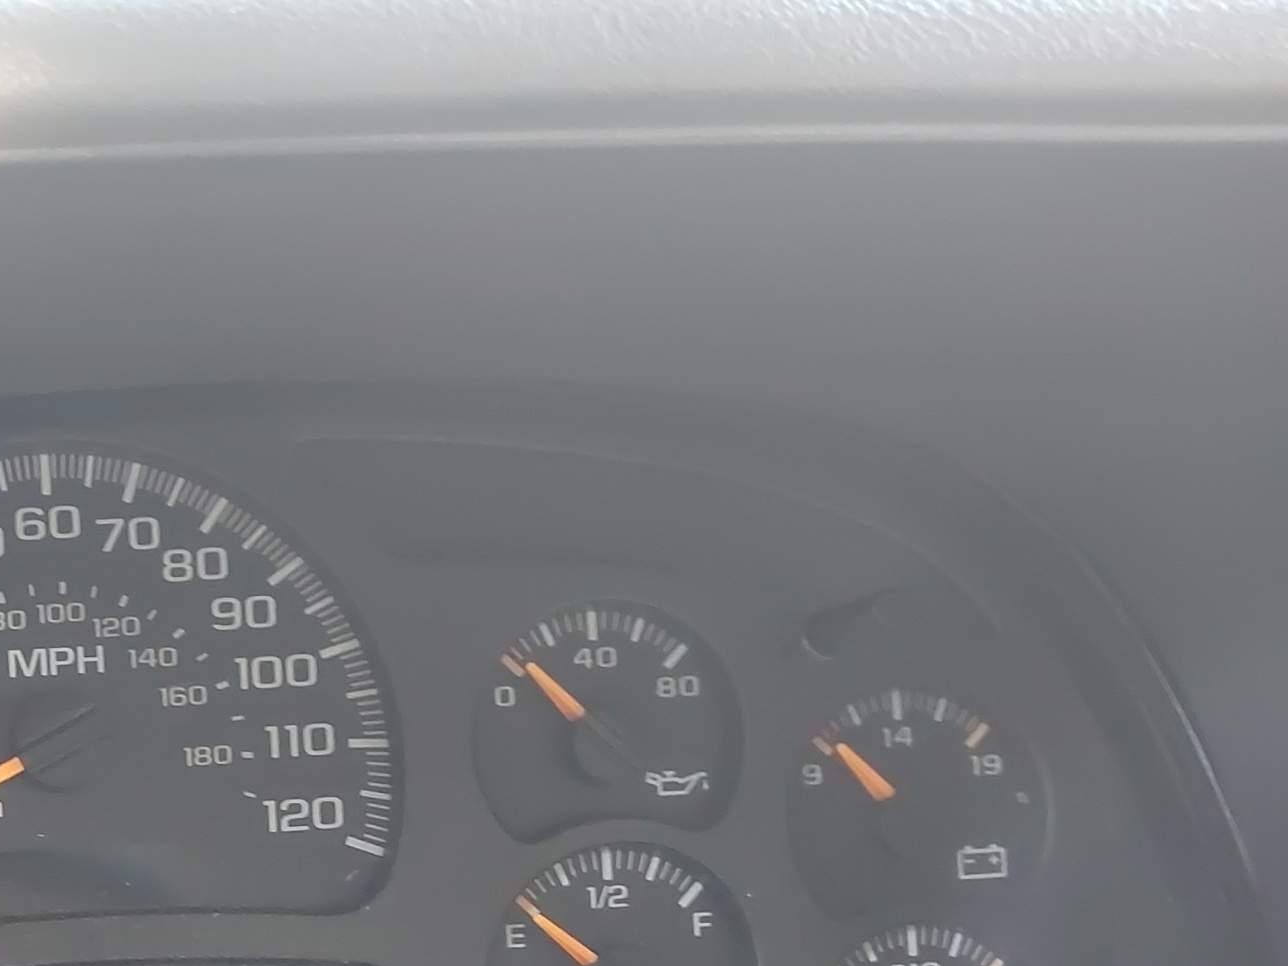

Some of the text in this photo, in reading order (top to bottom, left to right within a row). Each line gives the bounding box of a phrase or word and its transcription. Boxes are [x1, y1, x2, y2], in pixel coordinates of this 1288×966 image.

[15, 505, 81, 540] 60
[96, 517, 160, 552] 70
[162, 547, 228, 582] 80
[37, 603, 85, 624] 100
[211, 596, 277, 630] 90
[93, 617, 140, 637] 120
[8, 645, 104, 678] MPH
[128, 648, 178, 668] 140
[573, 647, 617, 668] 40
[235, 654, 317, 689] 100
[160, 686, 207, 707] 160
[494, 686, 515, 707] 0
[656, 676, 699, 697] 80
[265, 723, 335, 758] 110
[883, 727, 912, 747] 14
[184, 746, 232, 766] 180
[969, 755, 1003, 776] 19
[802, 765, 822, 785] 9
[263, 797, 344, 832] 120
[587, 886, 628, 908] 1/2
[694, 913, 712, 935] F
[506, 924, 525, 947] E
